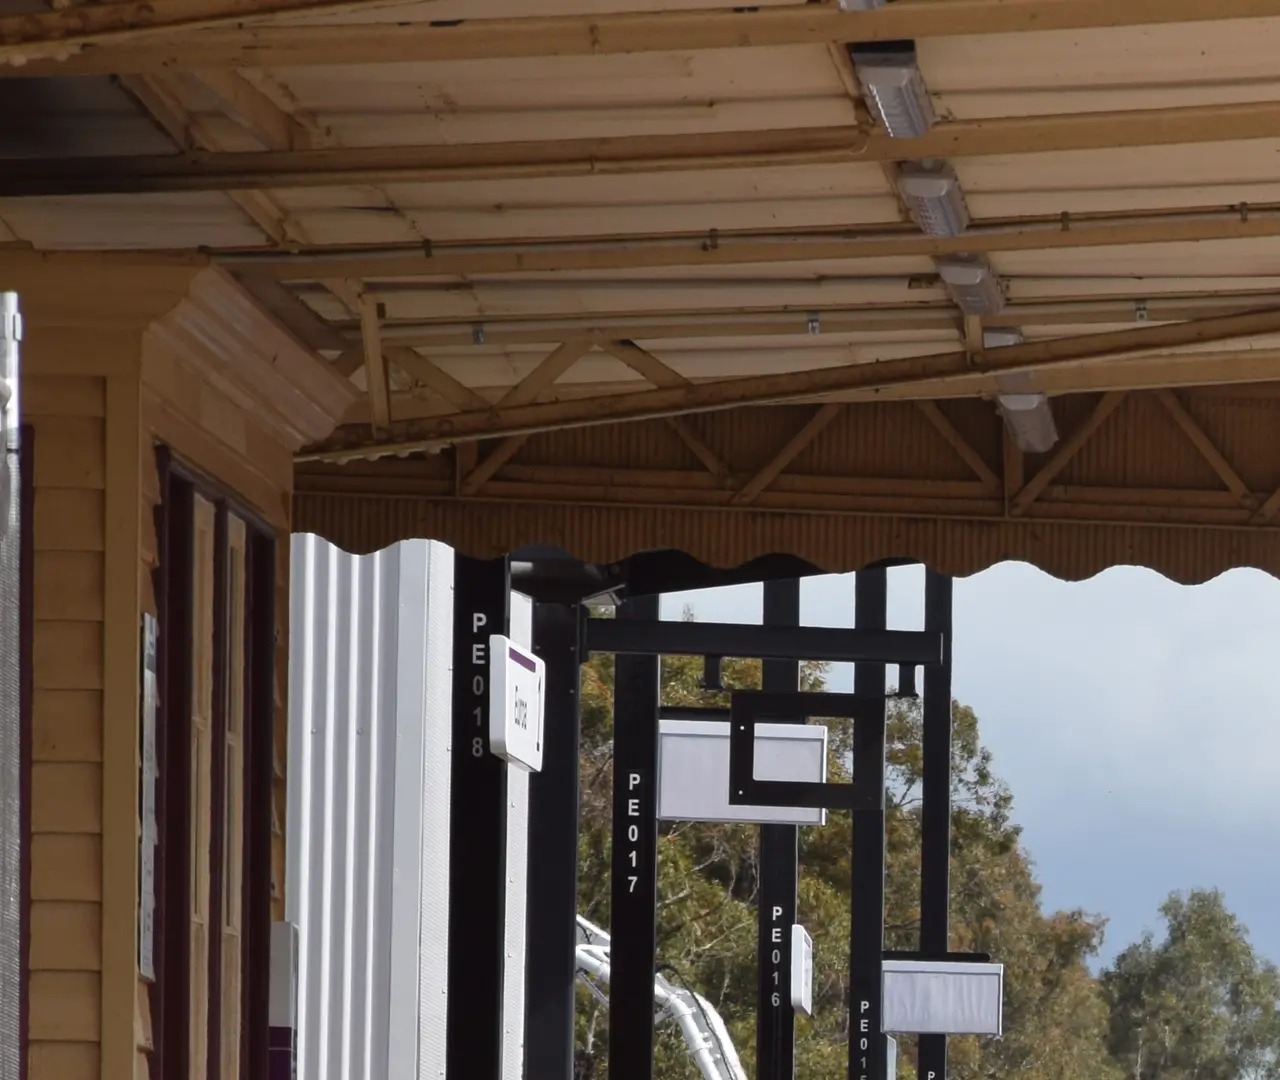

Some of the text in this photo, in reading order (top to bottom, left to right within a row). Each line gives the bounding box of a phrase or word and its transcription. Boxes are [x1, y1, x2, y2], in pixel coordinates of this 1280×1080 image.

[472, 612, 487, 757] PE018
[627, 773, 641, 893] PE017
[771, 905, 783, 1007] PE016
